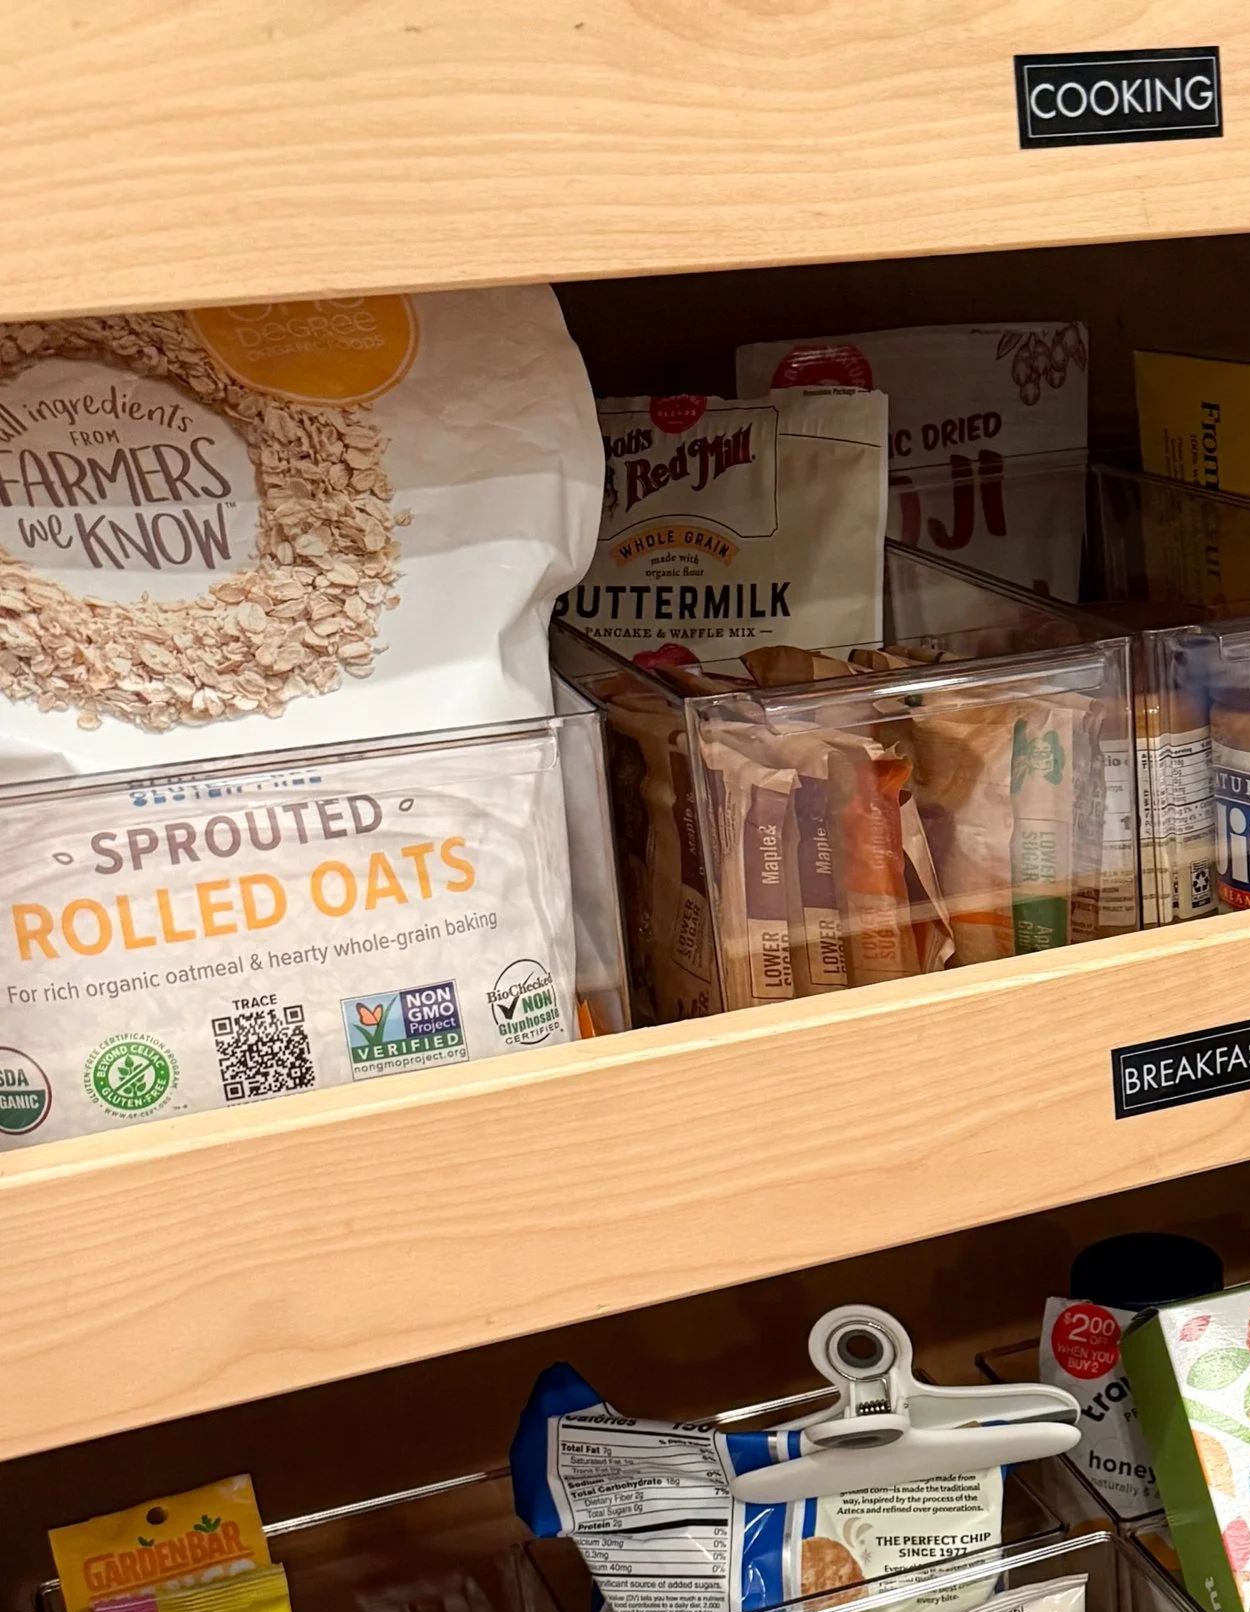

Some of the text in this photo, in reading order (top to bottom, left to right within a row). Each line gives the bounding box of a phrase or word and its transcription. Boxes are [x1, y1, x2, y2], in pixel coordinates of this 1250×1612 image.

[1030, 75, 1213, 119] COOKING
[22, 385, 194, 433] ingredients
[69, 429, 120, 446] FROM
[922, 412, 1002, 451] DRIED
[0, 436, 232, 508] FARMERS
[624, 442, 690, 512] Red
[18, 502, 232, 570] we KNOW
[619, 531, 730, 558] WHOLE GRAIN
[585, 627, 755, 638] PANCAKE WAFFLE MIX
[91, 794, 383, 875] SPROUTED
[760, 835, 782, 884] Maple
[813, 828, 832, 875] Maple
[11, 836, 476, 961] ROLLED OATS
[7, 911, 498, 1004] For rich organic oatmeal & hearty whole-grain baking
[762, 931, 782, 987] LOWER
[819, 919, 840, 974] LOWER
[406, 988, 450, 1008] NON
[486, 973, 553, 1004] BioChecked
[522, 989, 551, 1014] NON
[232, 994, 278, 1011] TRACE
[408, 1002, 454, 1023] GMO
[410, 1018, 456, 1034] Project
[499, 1007, 560, 1036] Glyphosate
[505, 1021, 561, 1045] CERTIFIED
[130, 1044, 165, 1068] CELIAC
[358, 1032, 459, 1060] VERIFIED
[354, 1048, 466, 1074] nongmoproject.org
[1057, 1343, 1115, 1364] WHEN YOU
[561, 1443, 601, 1455] Total Fat
[1089, 1451, 1157, 1484] honey
[598, 1478, 662, 1496] Carbohydrate
[862, 1494, 921, 1505] inspired by the
[940, 1483, 980, 1492] traditional
[578, 1521, 610, 1532] Protein
[876, 1532, 991, 1546] THE PERFECT CHIP
[84, 1520, 248, 1593] GARDENBAR
[899, 1547, 967, 1558] SINCE 1977
